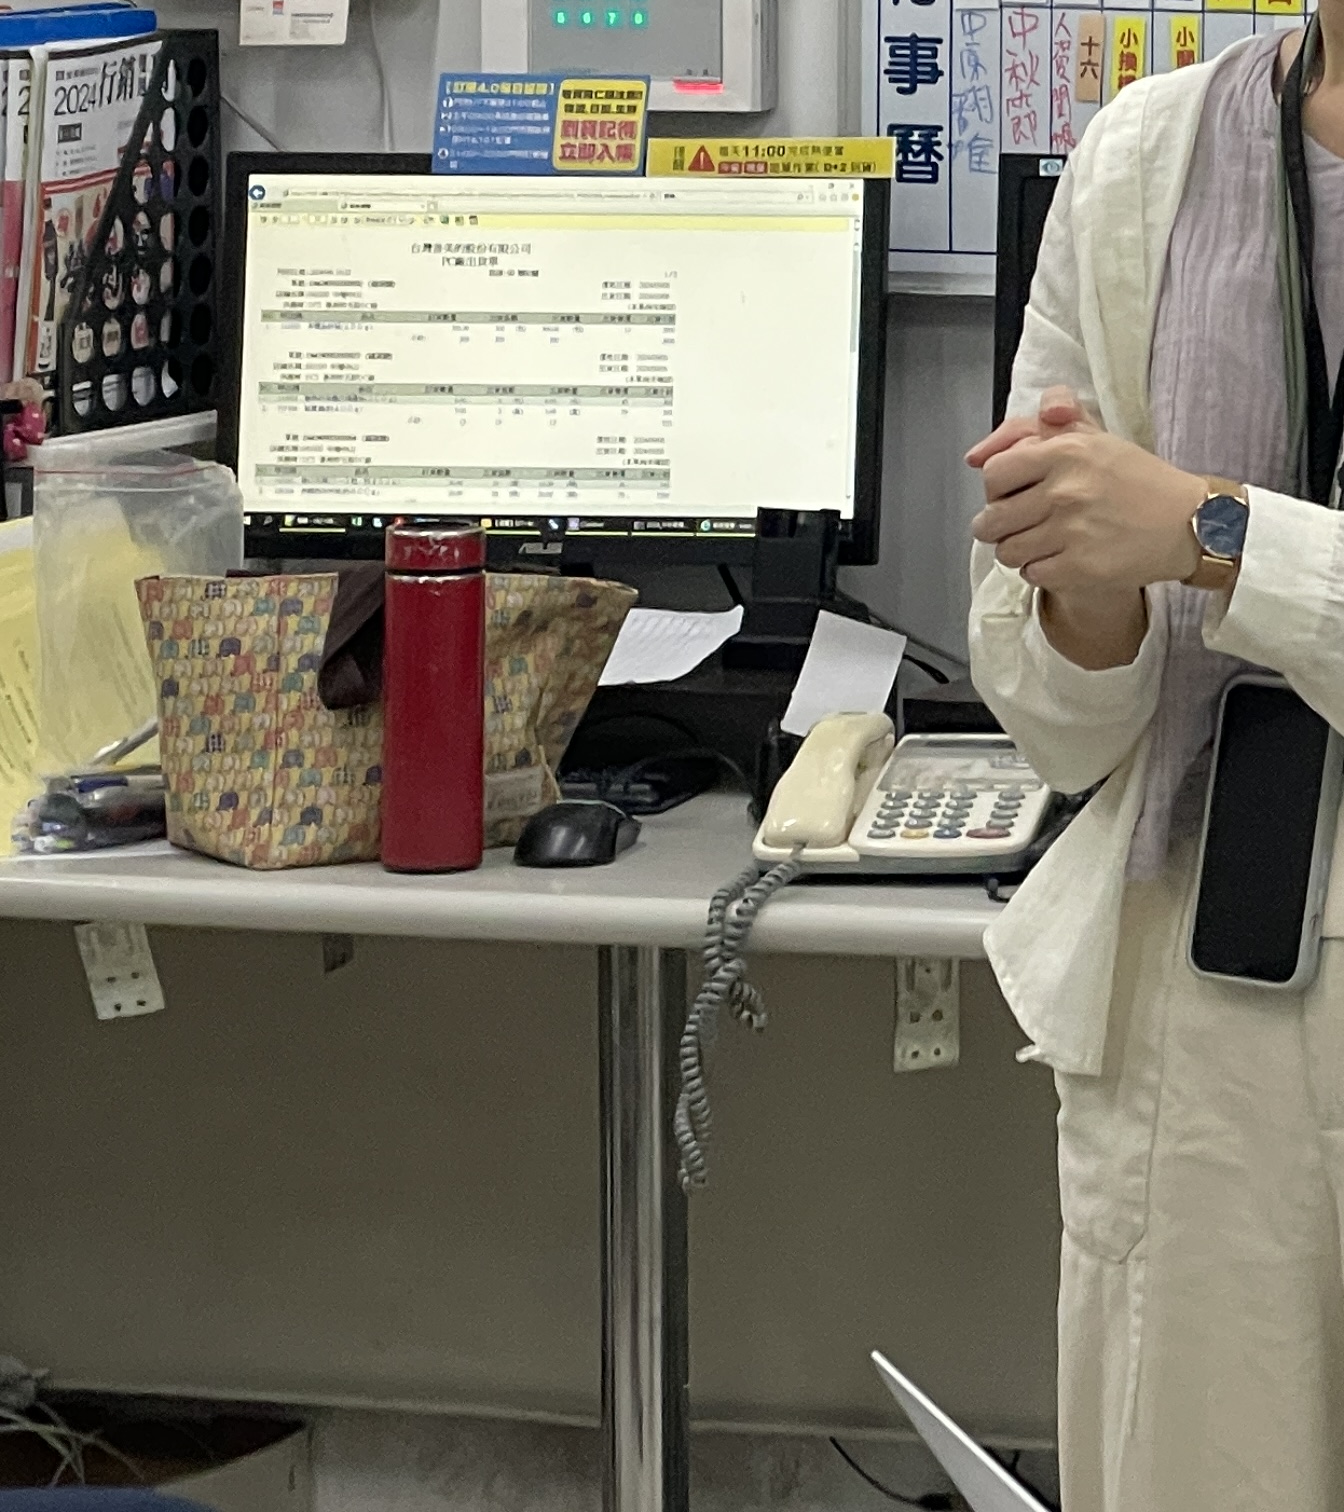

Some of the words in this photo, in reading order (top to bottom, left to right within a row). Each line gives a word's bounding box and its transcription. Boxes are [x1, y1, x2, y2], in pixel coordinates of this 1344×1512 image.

[1003, 6, 1042, 147] 中秋節
[1079, 36, 1100, 81] 十六
